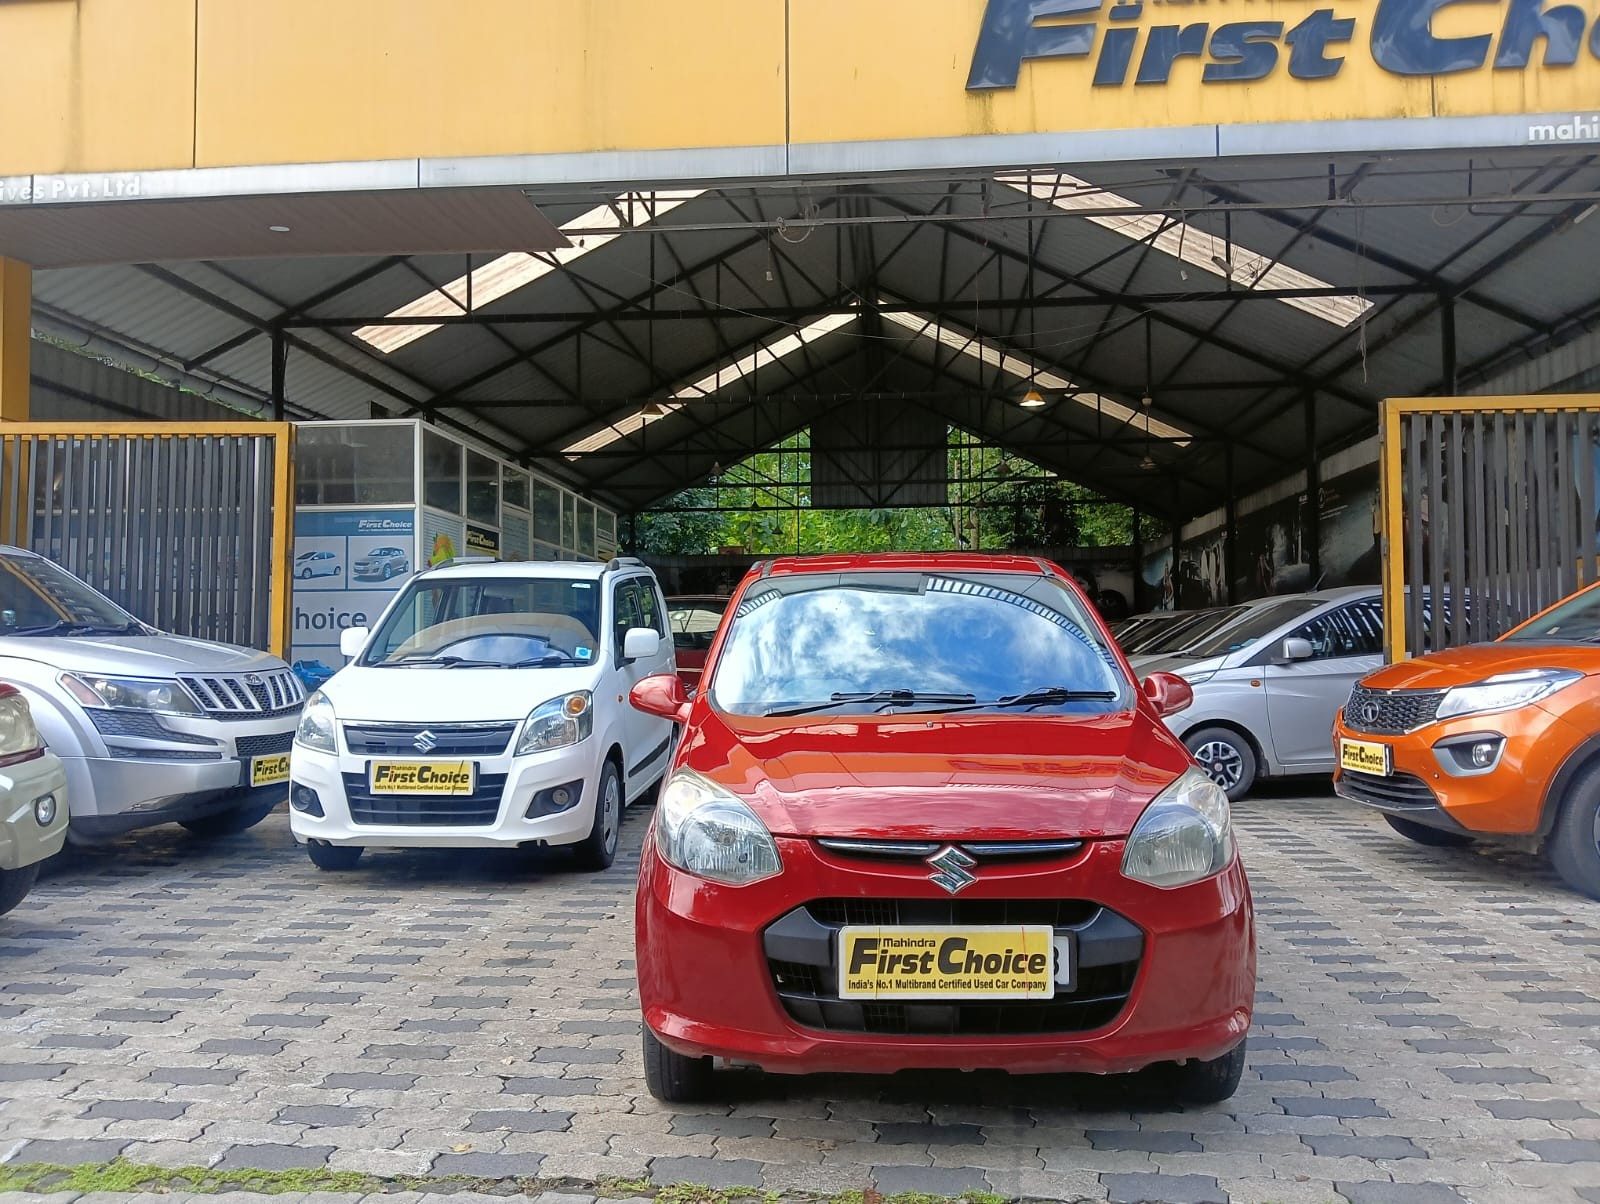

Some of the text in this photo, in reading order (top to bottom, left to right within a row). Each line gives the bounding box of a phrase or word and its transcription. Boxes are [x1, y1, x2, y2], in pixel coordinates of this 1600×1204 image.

[965, 0, 1600, 91] First Ch
[1528, 116, 1600, 141] mahi
[52, 179, 98, 199] Pvt.
[382, 519, 413, 528] Choice
[1343, 743, 1384, 766] First Choice
[254, 759, 278, 777] First
[375, 765, 470, 784] First Choice
[883, 937, 936, 948] Mahindra
[849, 937, 935, 975] First
[937, 937, 1047, 975] Choice
[848, 978, 1047, 992] India's No.1 Multibrand Certified Used Car Company
